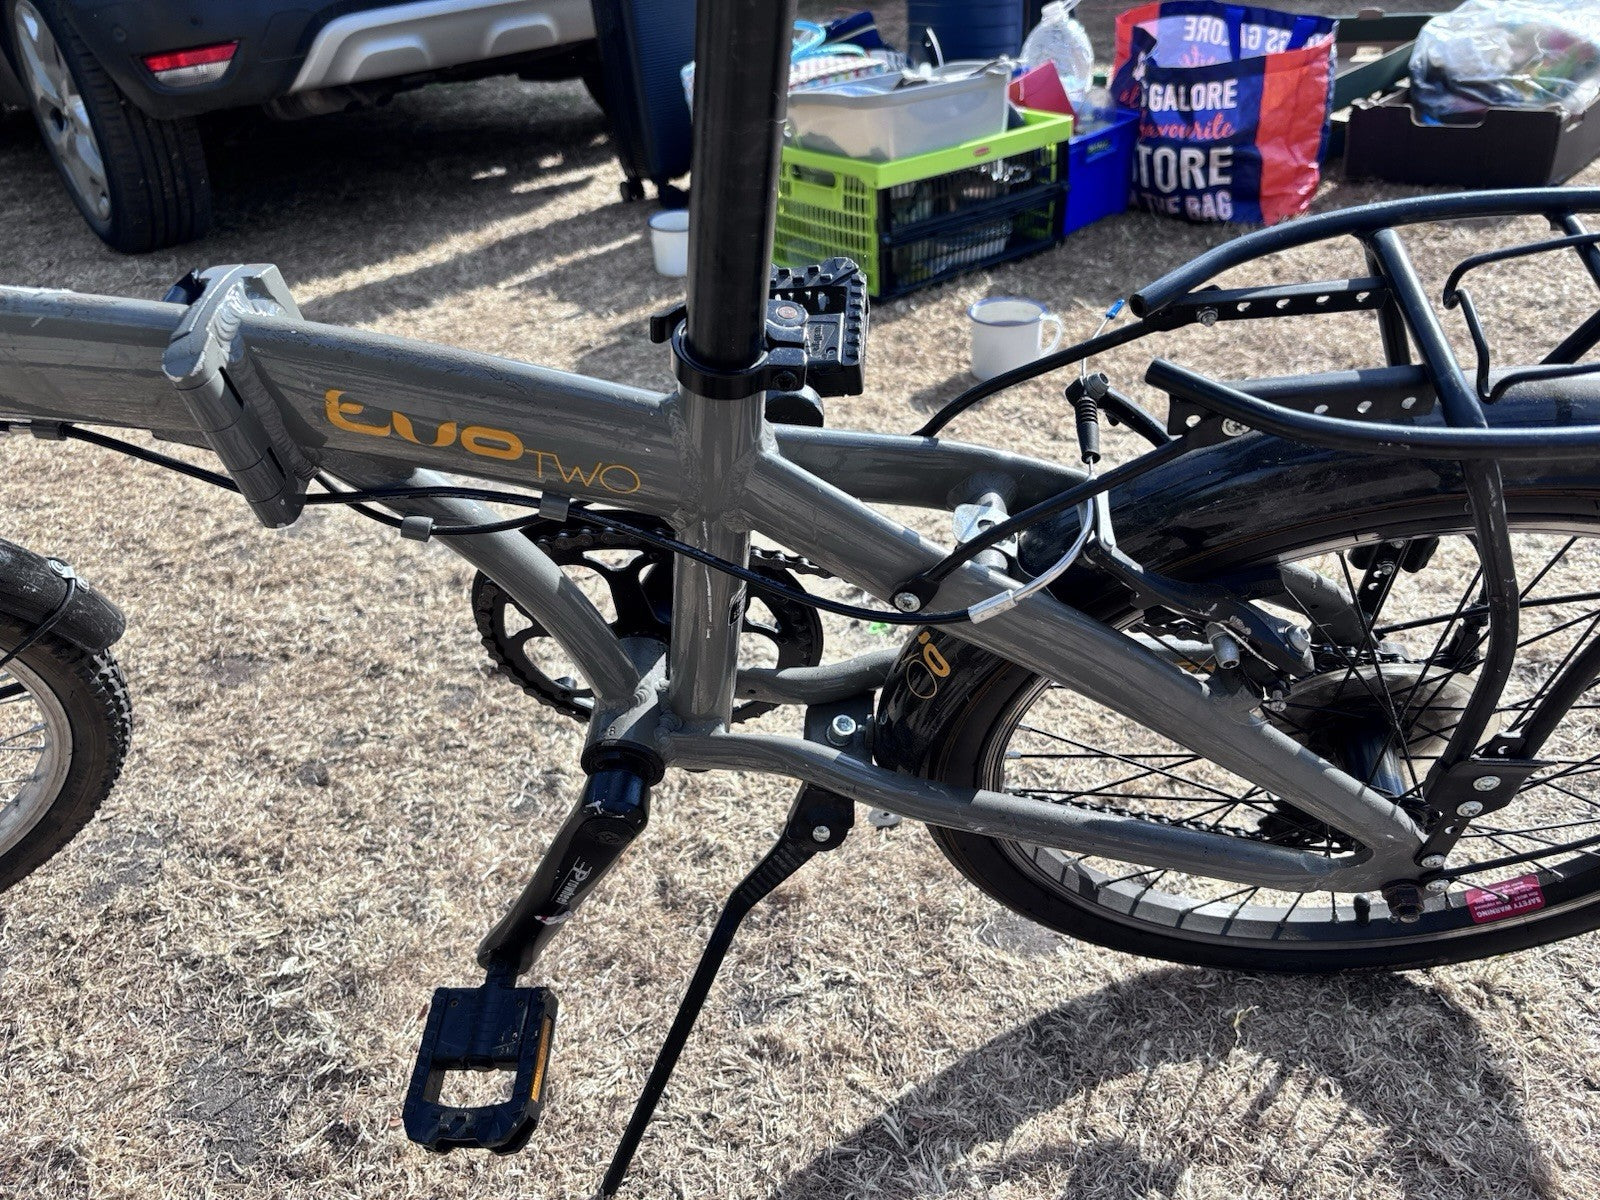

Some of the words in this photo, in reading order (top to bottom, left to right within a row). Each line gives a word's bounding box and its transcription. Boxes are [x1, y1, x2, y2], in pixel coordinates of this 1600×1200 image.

[1148, 78, 1238, 112] GALORE
[1131, 145, 1234, 194] TORE
[1184, 189, 1234, 221] BAG
[324, 389, 524, 461] EVO
[524, 449, 641, 494] TWO
[1476, 904, 1512, 918] WARNING
[1513, 896, 1541, 909] SAFETY
